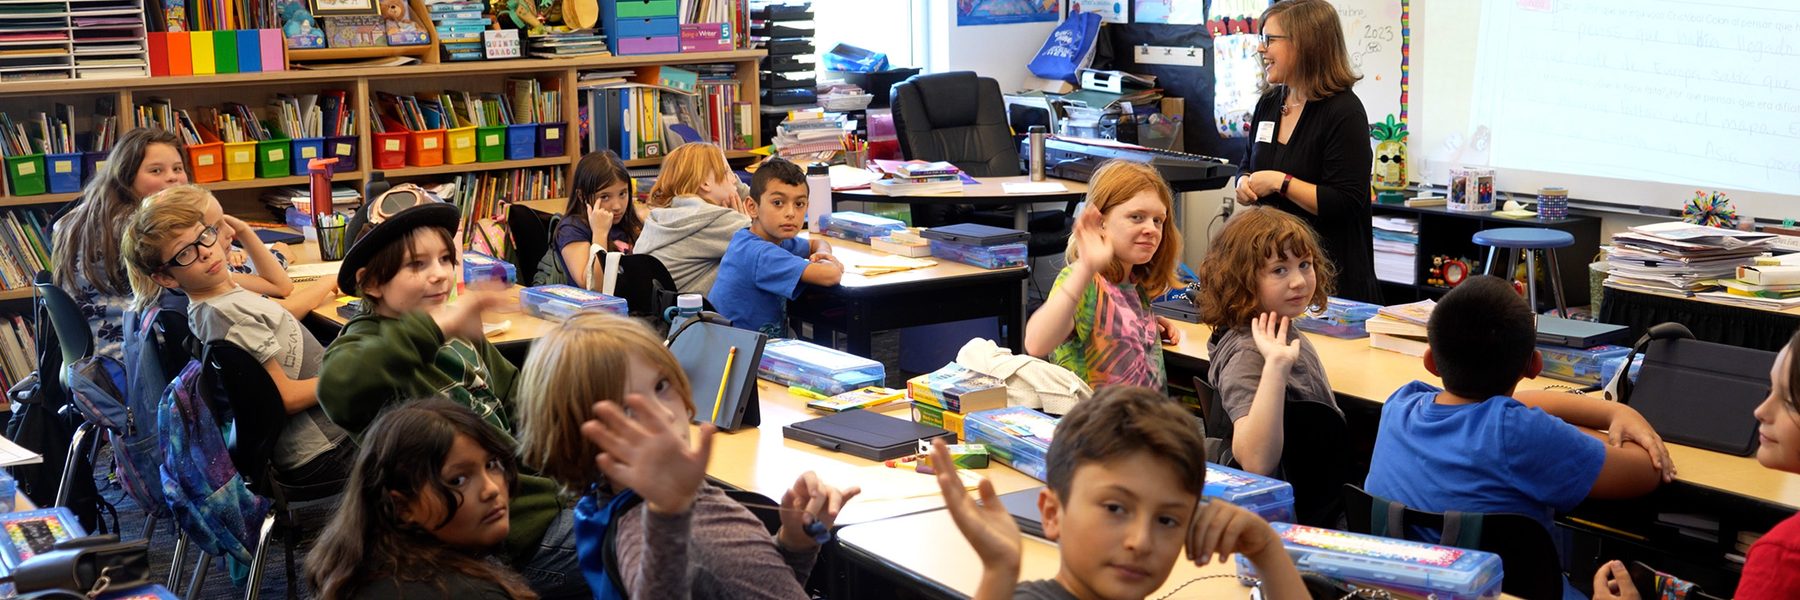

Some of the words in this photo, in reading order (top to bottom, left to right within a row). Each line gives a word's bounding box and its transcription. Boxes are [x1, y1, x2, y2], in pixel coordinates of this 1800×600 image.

[722, 27, 729, 37] 5
[1364, 25, 1394, 42] 2023
[486, 40, 520, 48] QUINTO
[490, 48, 517, 56] GRADO
